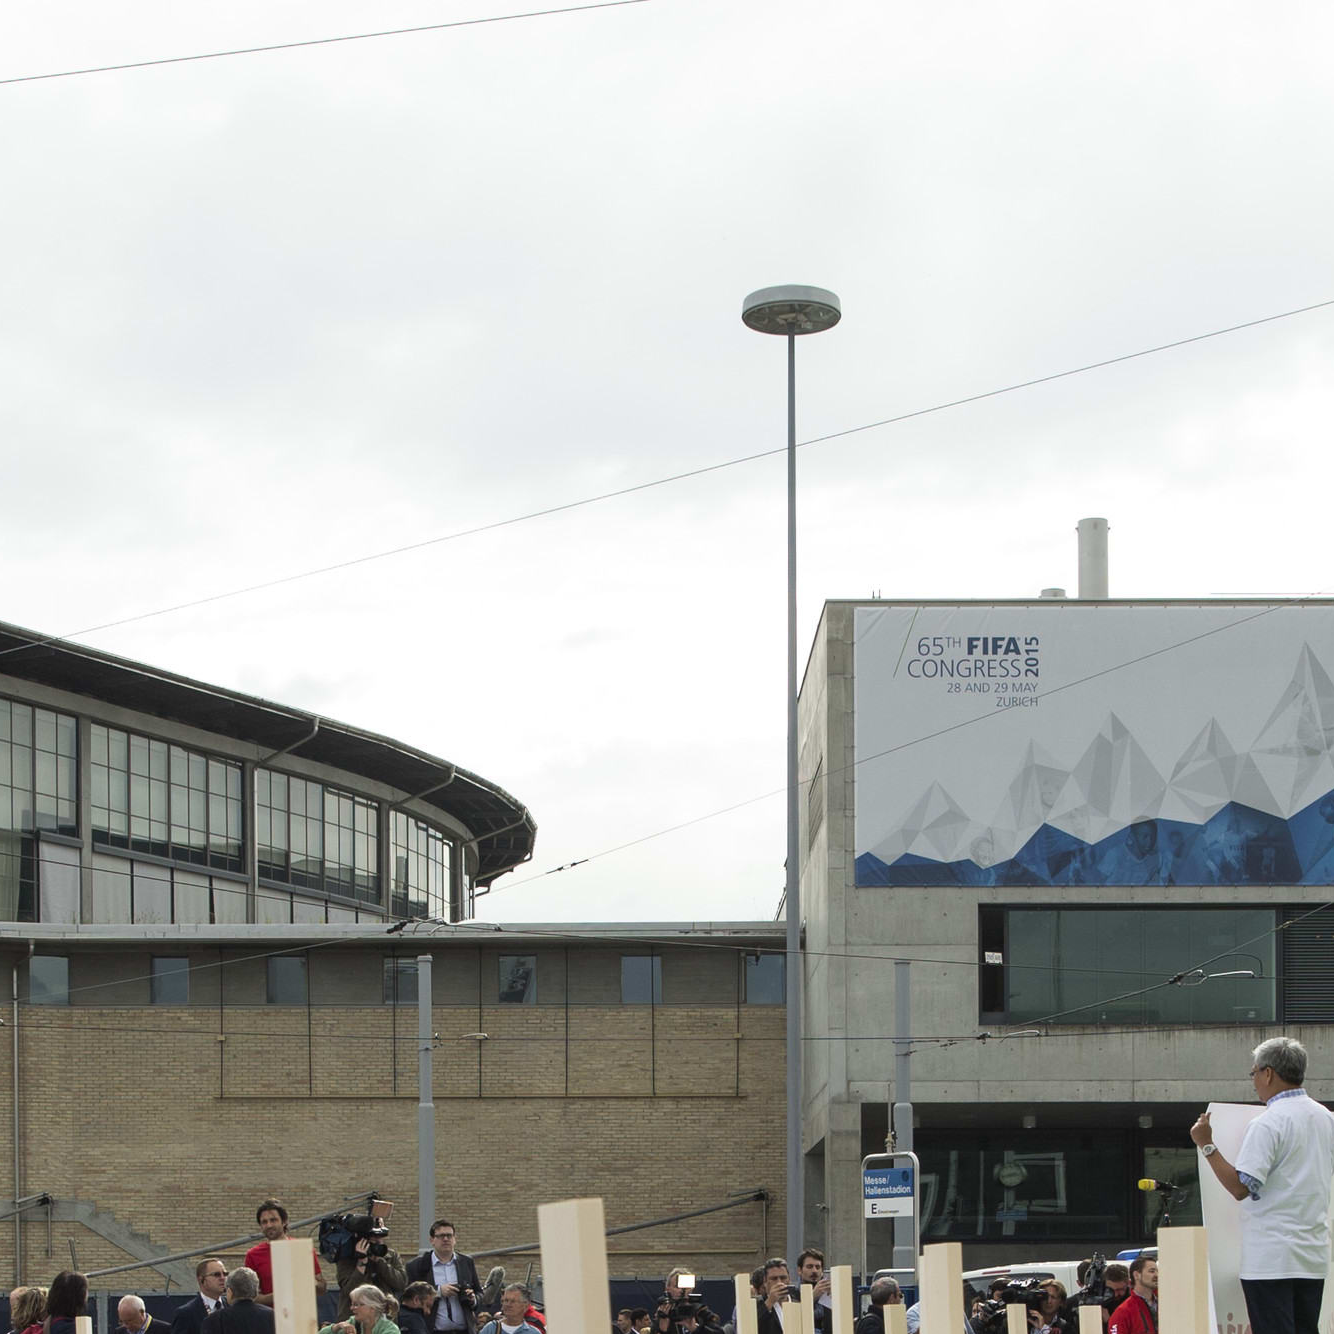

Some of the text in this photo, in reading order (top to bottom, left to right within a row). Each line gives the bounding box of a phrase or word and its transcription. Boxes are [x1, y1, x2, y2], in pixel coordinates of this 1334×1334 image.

[917, 636, 1021, 656] 65TH FIFA
[1024, 636, 1040, 678] 2015
[907, 658, 1021, 679] CONGRESS
[947, 682, 1039, 693] 28 AND 29 MAY
[996, 696, 1039, 707] ZURICH
[865, 1184, 912, 1196] Hallenstadion
[871, 1203, 878, 1215] E
